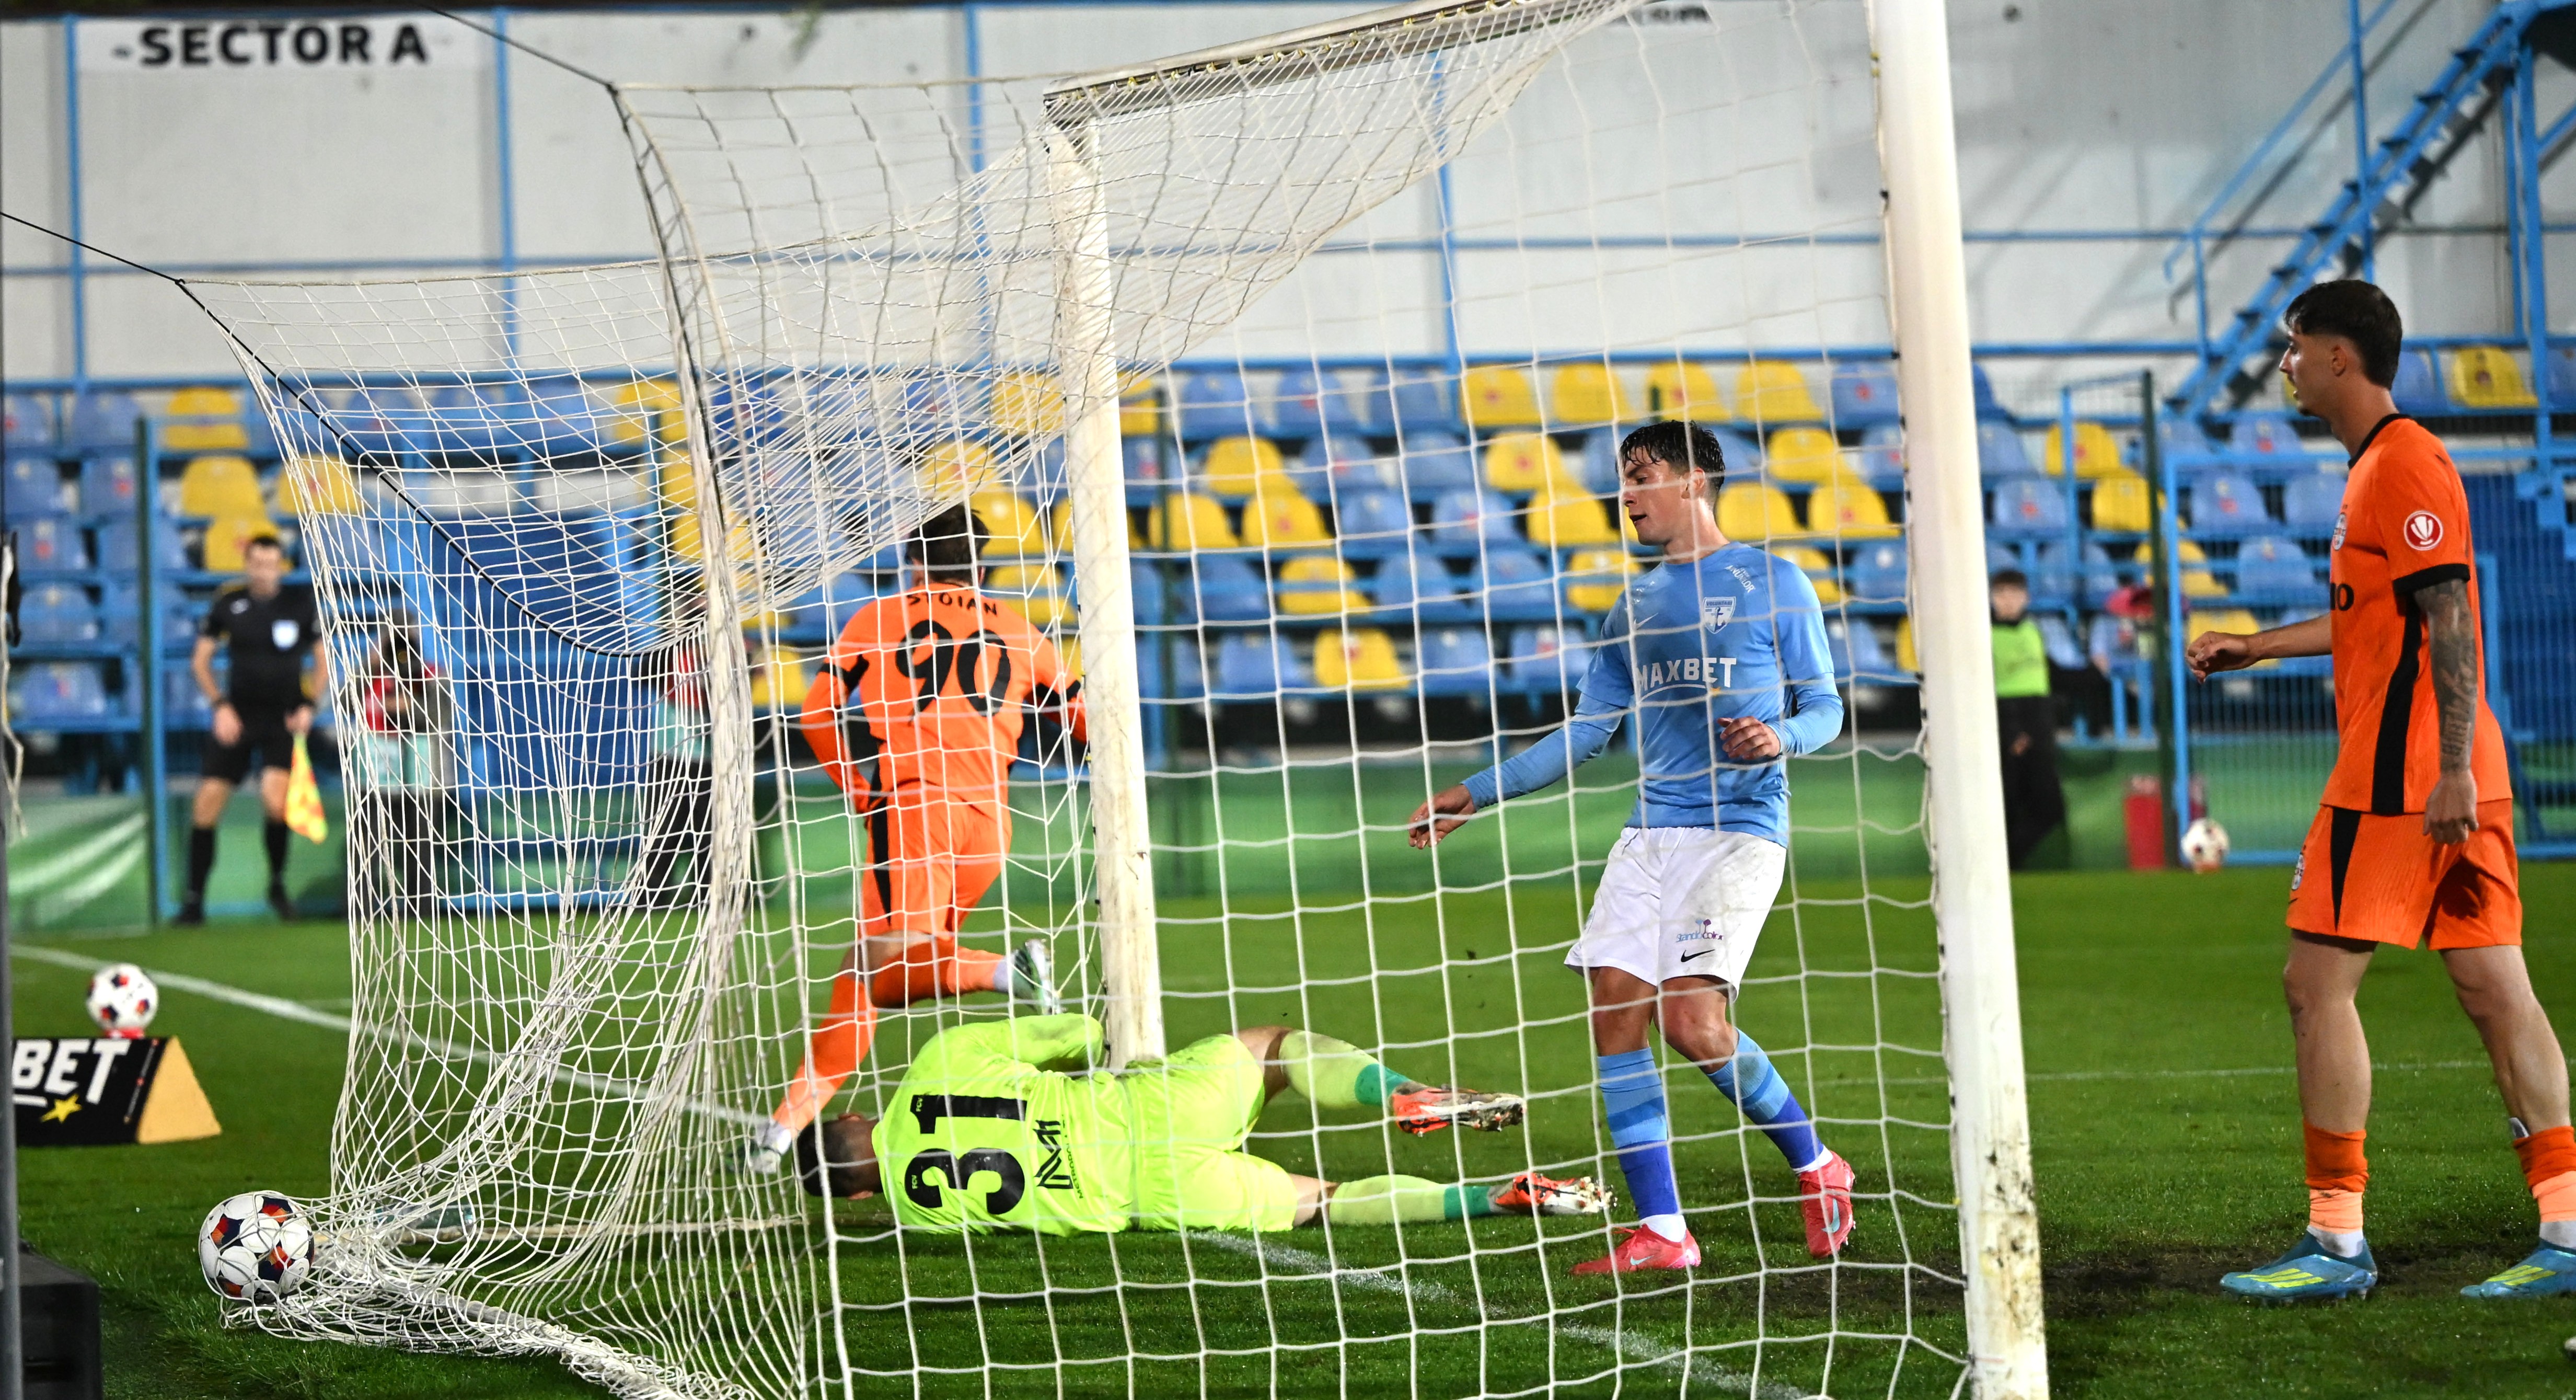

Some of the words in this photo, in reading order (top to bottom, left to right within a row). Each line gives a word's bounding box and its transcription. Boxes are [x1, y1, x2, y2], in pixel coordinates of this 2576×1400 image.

[389, 24, 429, 64] A
[895, 619, 1011, 725] 90
[1635, 658, 1737, 691] MAXBET
[12, 1039, 131, 1105] BET
[905, 1094, 1027, 1215] 31
